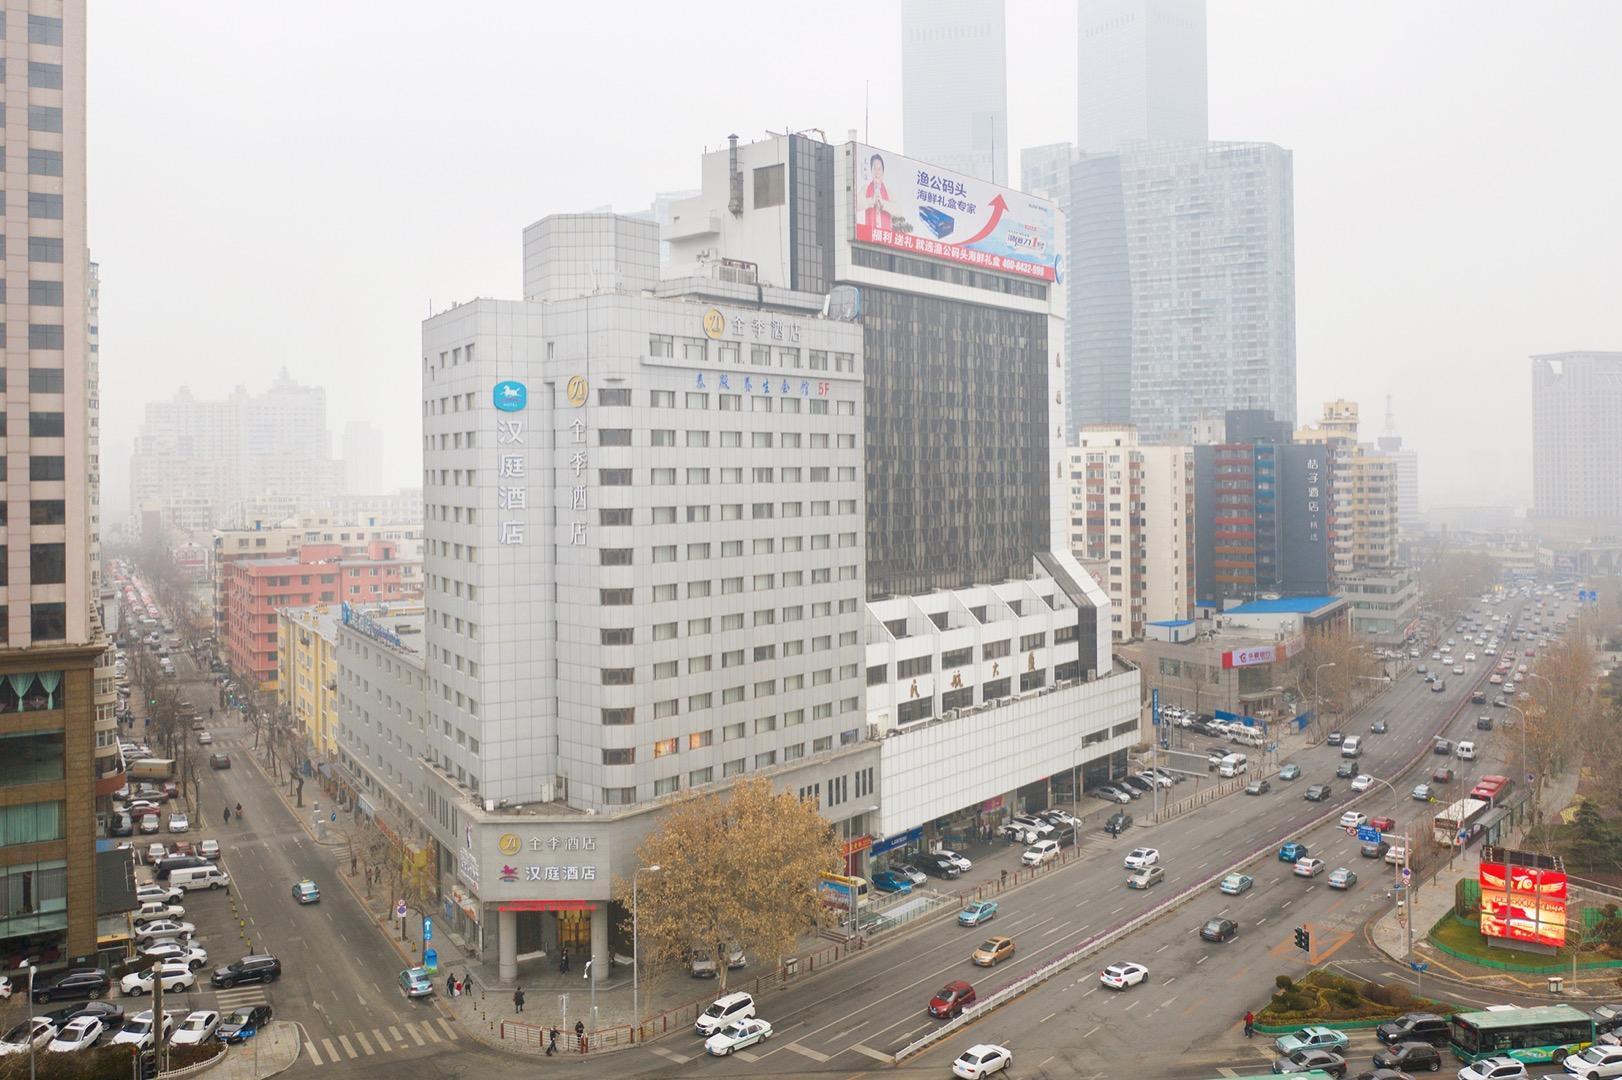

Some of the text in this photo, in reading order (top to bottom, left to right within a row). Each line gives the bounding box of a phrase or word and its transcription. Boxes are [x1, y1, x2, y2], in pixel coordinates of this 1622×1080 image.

[916, 169, 968, 198] 渔公码头
[916, 188, 977, 215] 海鲜礼盒专家
[871, 228, 893, 245] 福利
[894, 232, 913, 250] 送礼
[731, 315, 801, 343] 全季酒店
[818, 382, 830, 397] 5F
[497, 419, 526, 546] 汉庭酒店
[569, 417, 588, 546] 全季酒店
[527, 836, 598, 851] 全季酒店
[525, 865, 596, 881] 汉庭酒店
